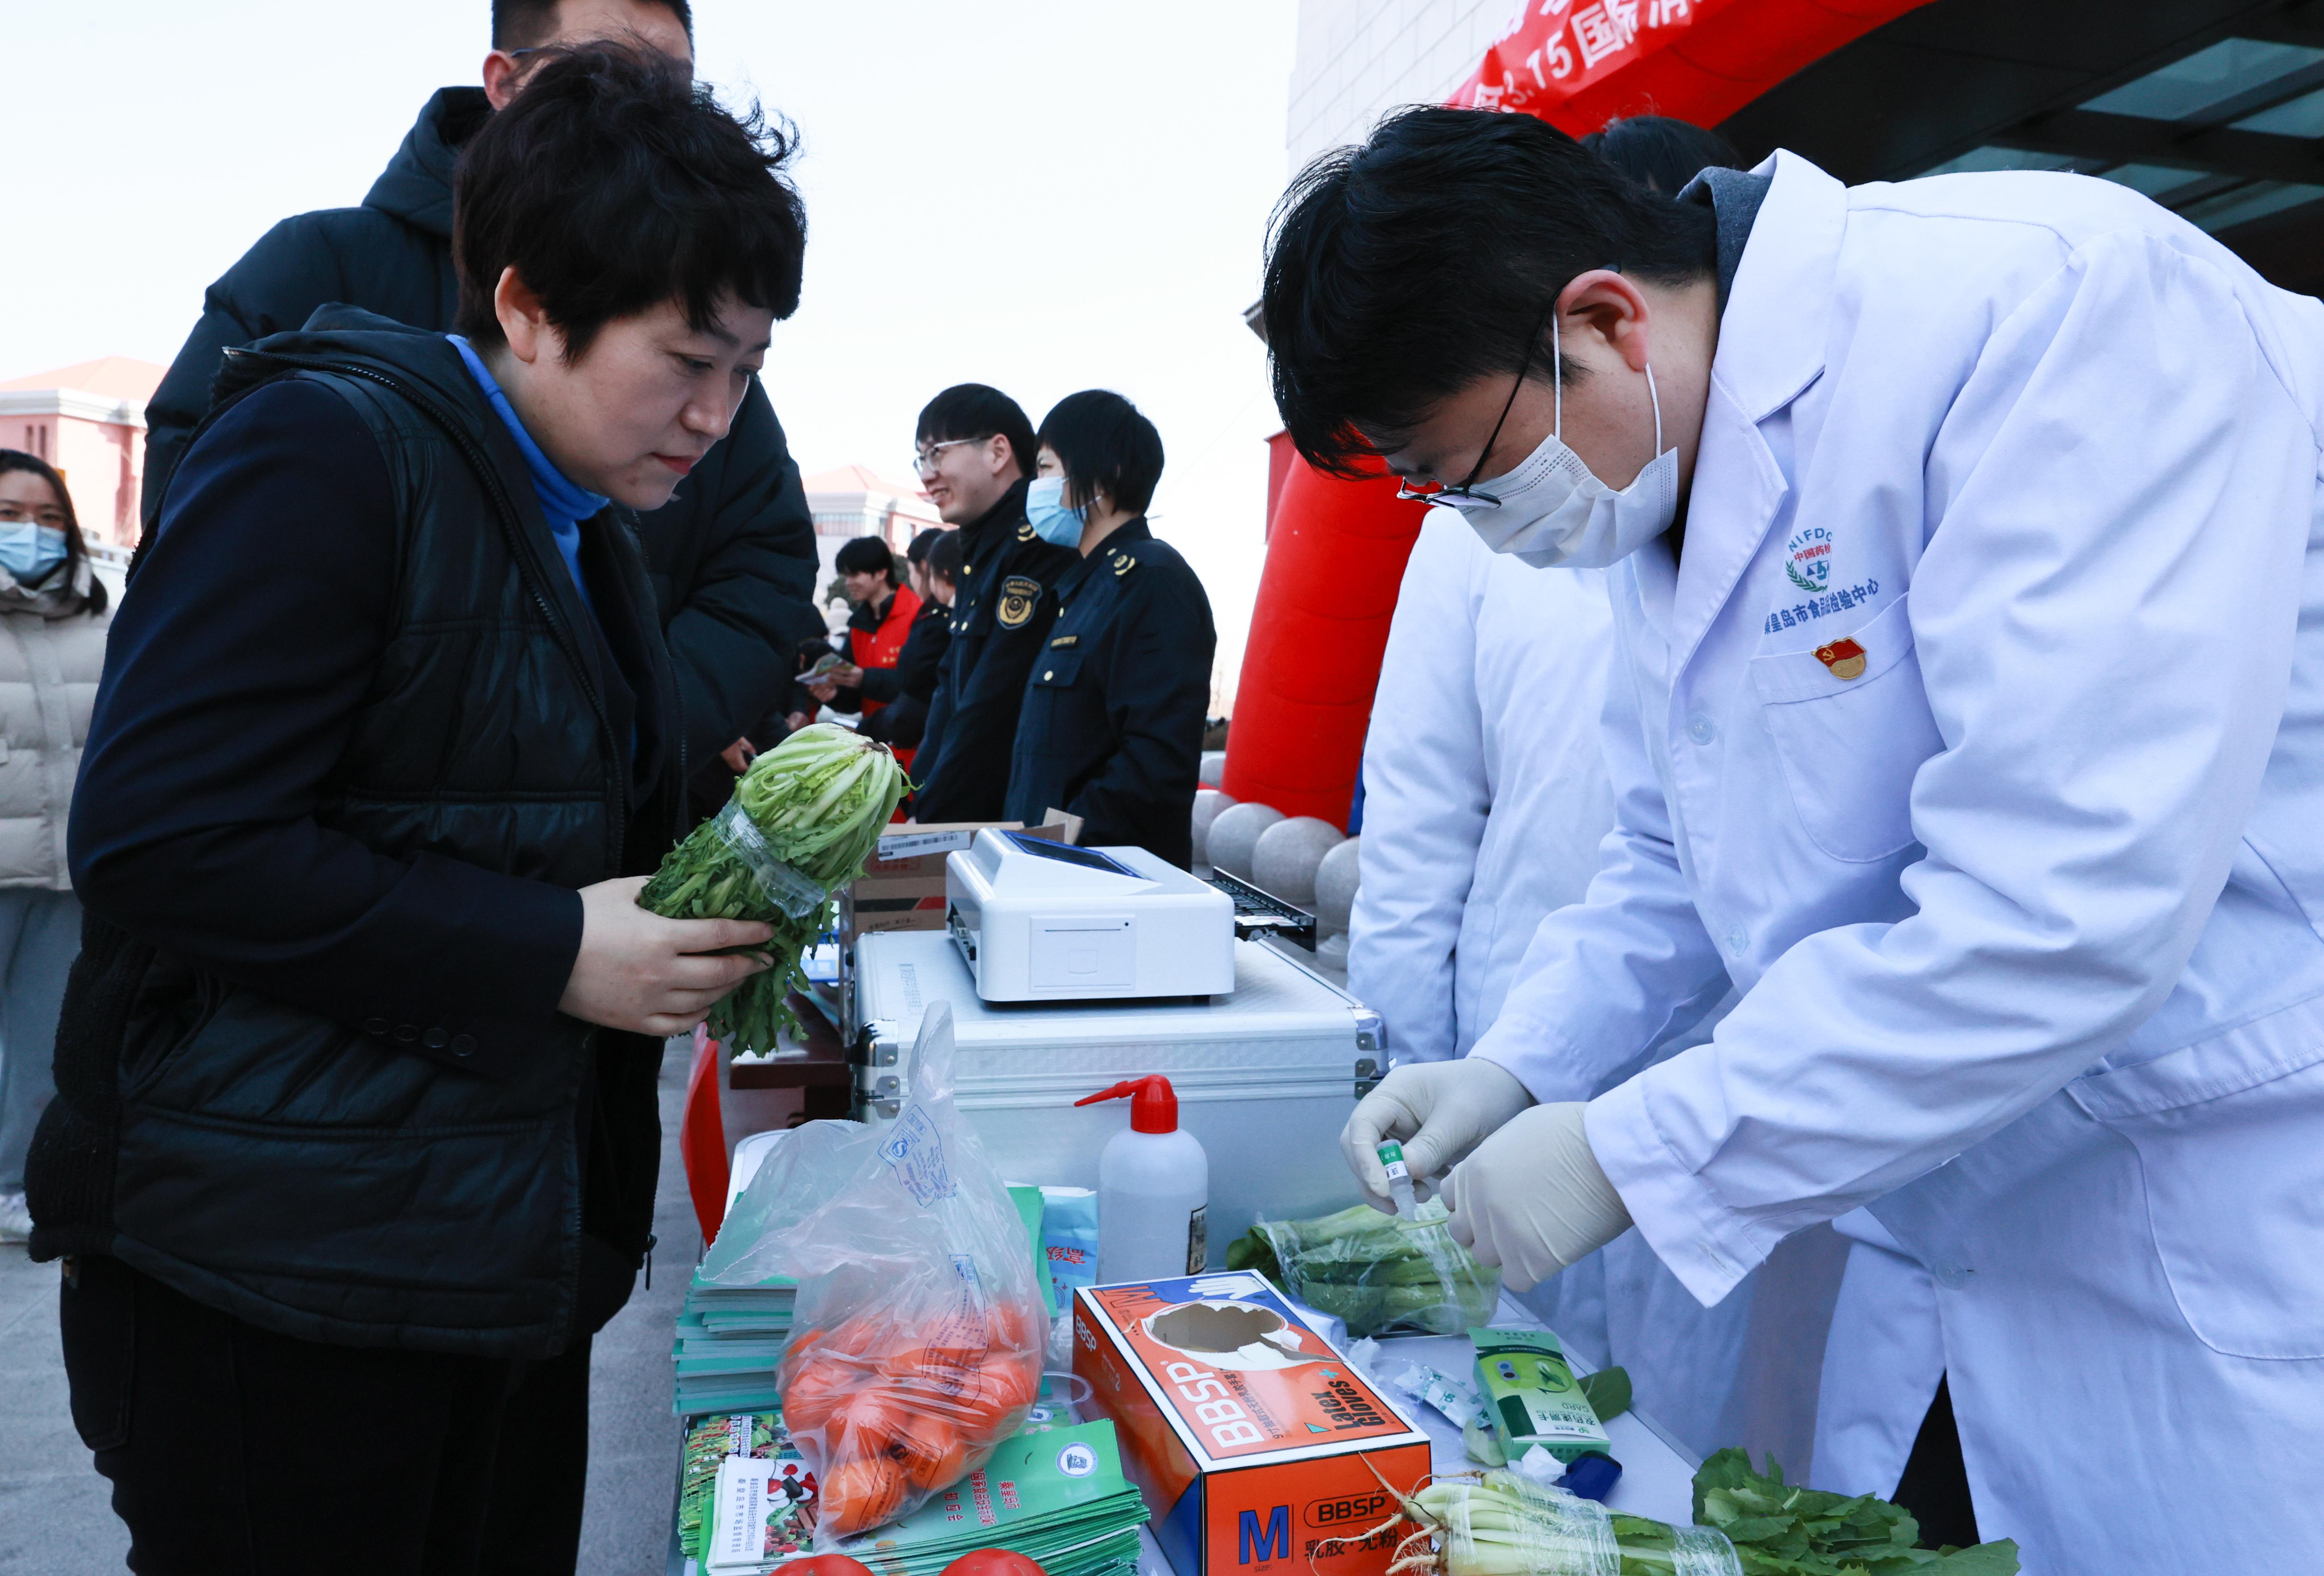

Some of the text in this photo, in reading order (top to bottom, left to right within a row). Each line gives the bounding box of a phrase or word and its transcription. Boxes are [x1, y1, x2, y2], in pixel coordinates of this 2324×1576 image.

[1789, 528, 1832, 552] NIFDC
[1046, 1246, 1086, 1265] 高级
[1076, 1314, 1097, 1352] BBSP
[1311, 1391, 1362, 1430] Latex
[1328, 1380, 1386, 1426] Gloves
[1539, 1413, 1595, 1426] 农药速测卡
[1562, 1403, 1589, 1413] CARD
[943, 1485, 964, 1522] 知应会
[970, 1467, 998, 1526] 国家食品安全示范城市
[998, 1481, 1021, 1510] 秦皇岛市
[1318, 1496, 1386, 1522] BBSP
[1239, 1505, 1289, 1565] M
